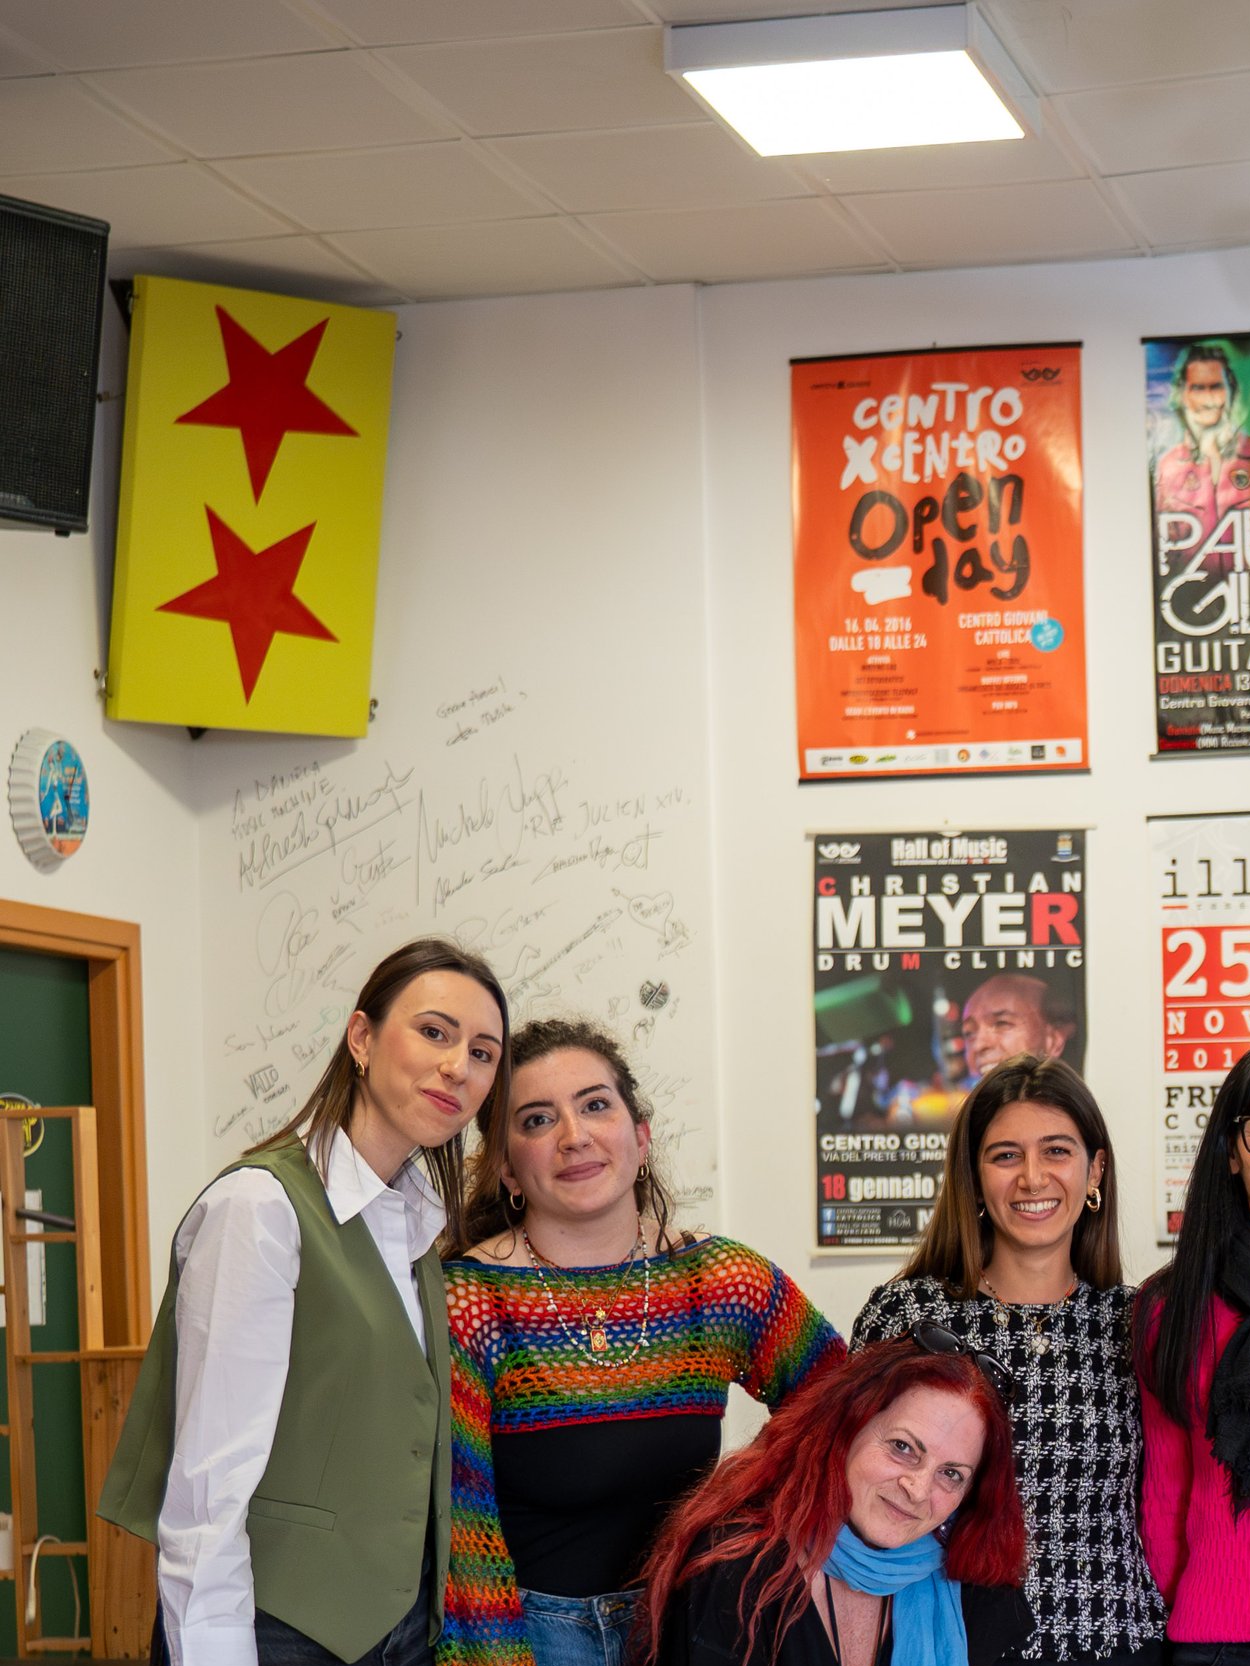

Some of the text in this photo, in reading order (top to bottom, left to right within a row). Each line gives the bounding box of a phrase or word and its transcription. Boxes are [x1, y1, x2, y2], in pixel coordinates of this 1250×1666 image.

[958, 612, 1001, 629] CENTRO
[828, 635, 865, 652] DALLE
[884, 633, 911, 650] ALLE
[1159, 673, 1232, 695] DOMENICA
[1235, 672, 1250, 691] 13
[1160, 694, 1206, 709] Centro
[891, 835, 1008, 861] Hall of Music
[818, 871, 1082, 897] CHRISTIAN
[817, 892, 1082, 949] MEYER
[818, 950, 1083, 972] DRUM CLINIC
[1166, 1049, 1234, 1070] 201
[821, 1133, 951, 1151] CENTRO GIOV
[822, 1152, 840, 1163] VIA
[841, 1151, 861, 1163] DEL
[864, 1150, 897, 1162] PRETE
[822, 1172, 935, 1203] 18 gennaio
